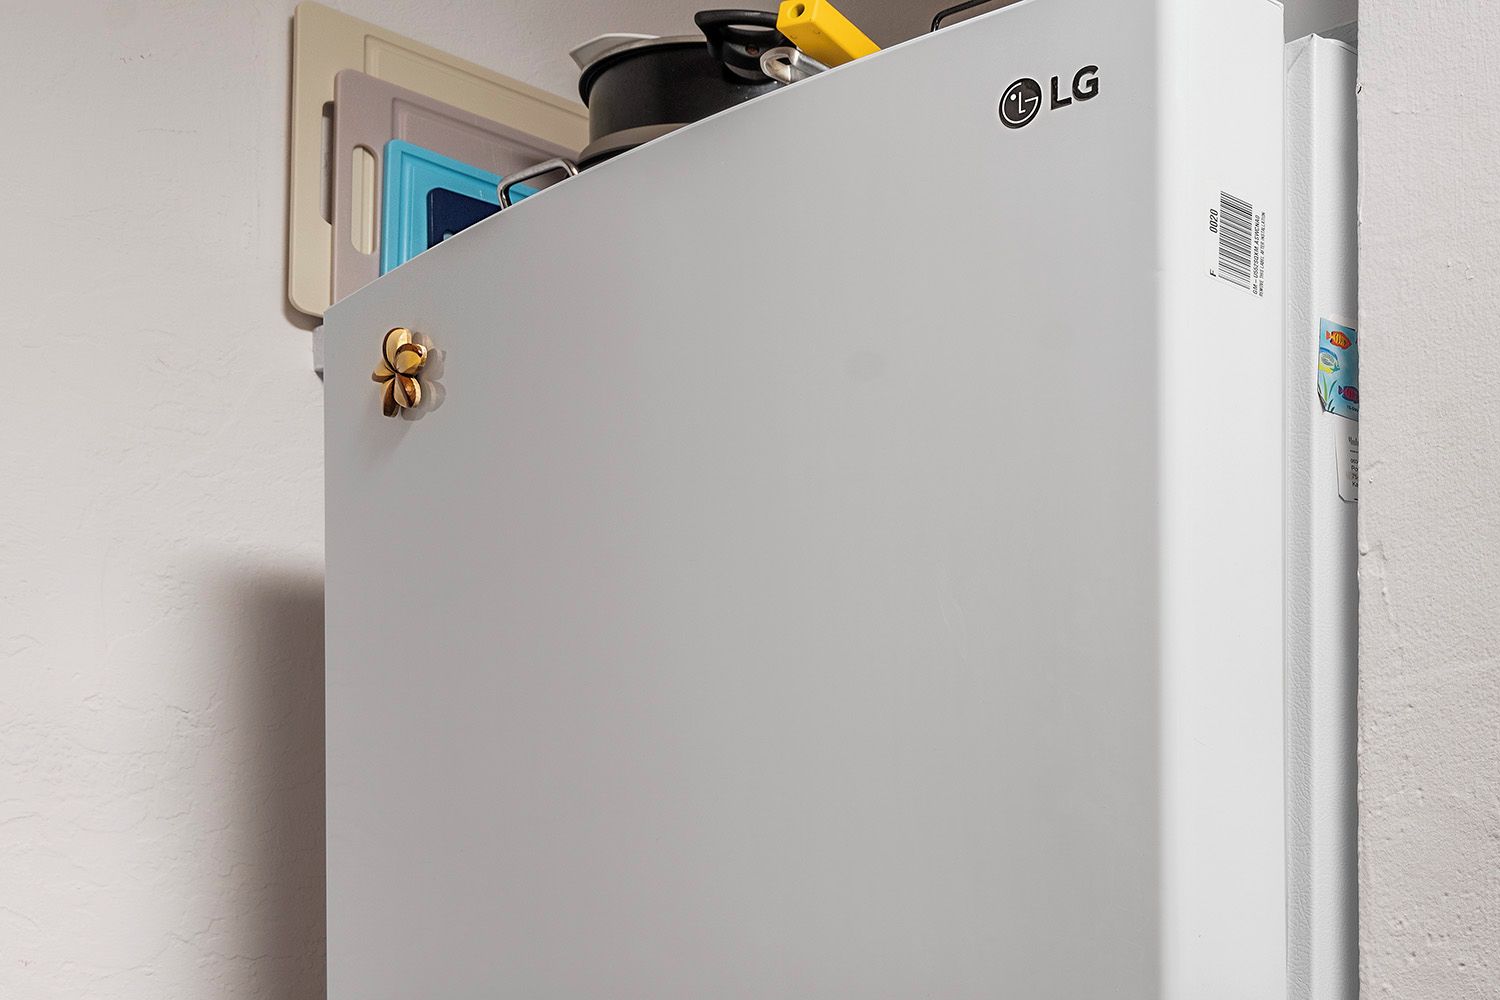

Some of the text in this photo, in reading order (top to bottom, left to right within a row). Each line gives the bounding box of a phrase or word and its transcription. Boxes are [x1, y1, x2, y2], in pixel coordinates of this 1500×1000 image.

[1050, 65, 1099, 111] LG
[1208, 208, 1219, 234] 0020
[1209, 268, 1217, 277] F
